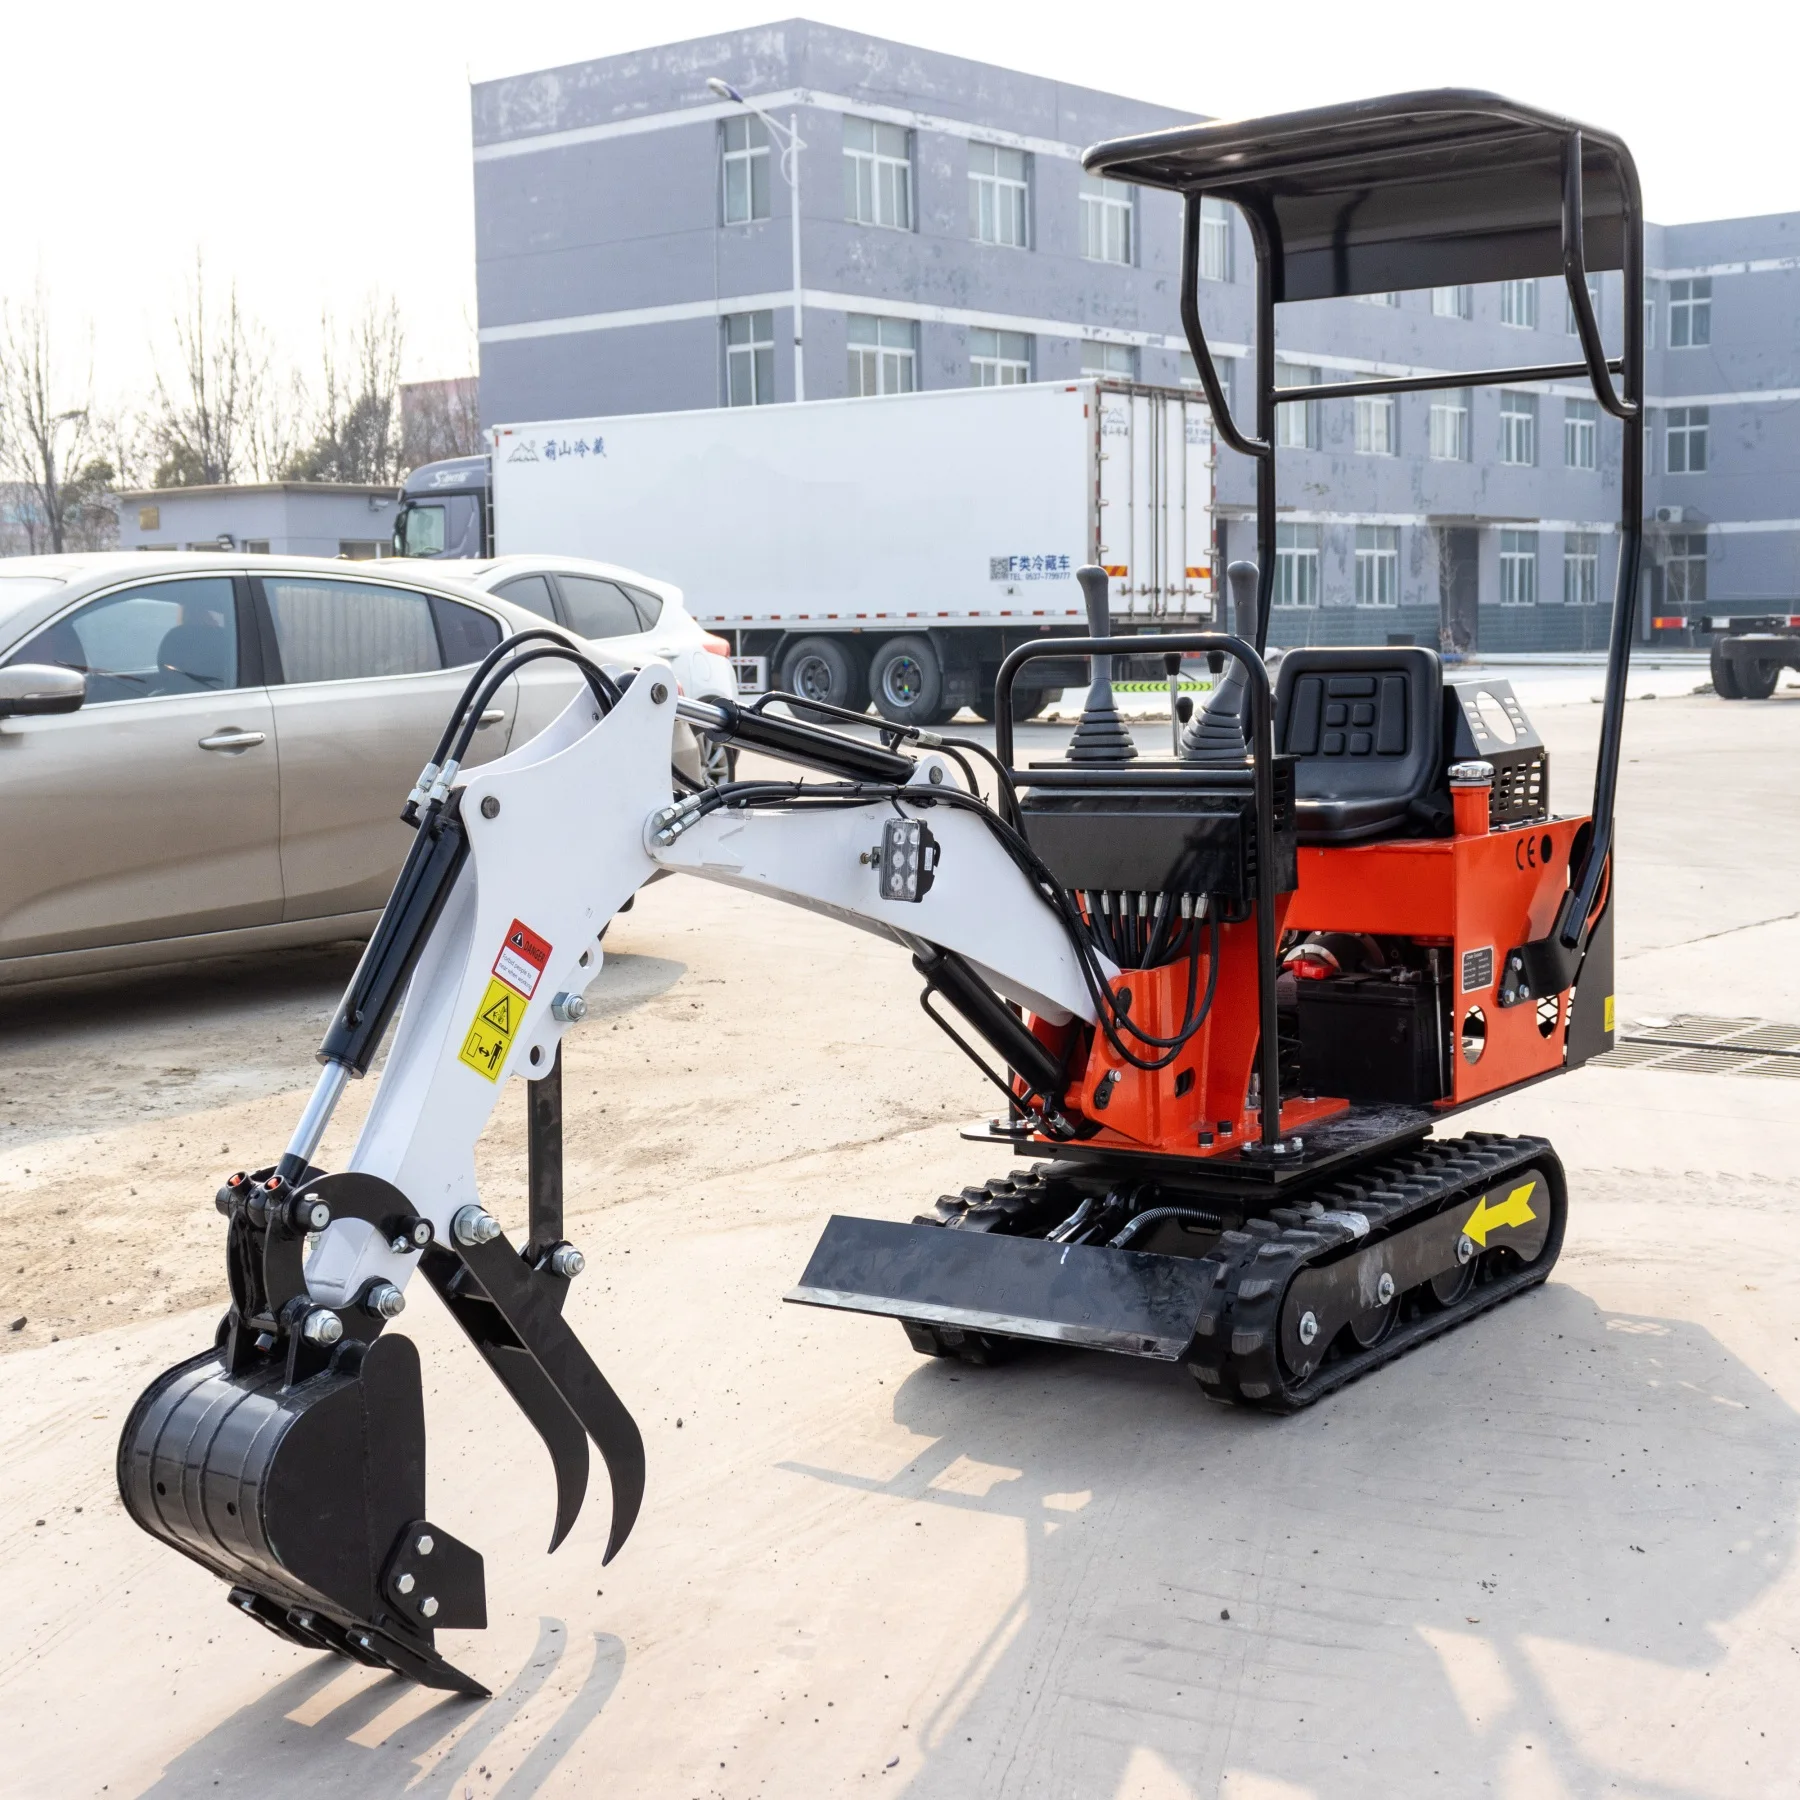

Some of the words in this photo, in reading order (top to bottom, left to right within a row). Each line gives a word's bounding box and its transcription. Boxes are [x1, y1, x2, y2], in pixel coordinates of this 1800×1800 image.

[1009, 555, 1070, 571] F类冷藏车
[523, 941, 546, 963] DANGER
[503, 953, 515, 967] Forbid
[514, 963, 528, 976] people
[508, 969, 518, 979] when
[518, 977, 532, 991] working
